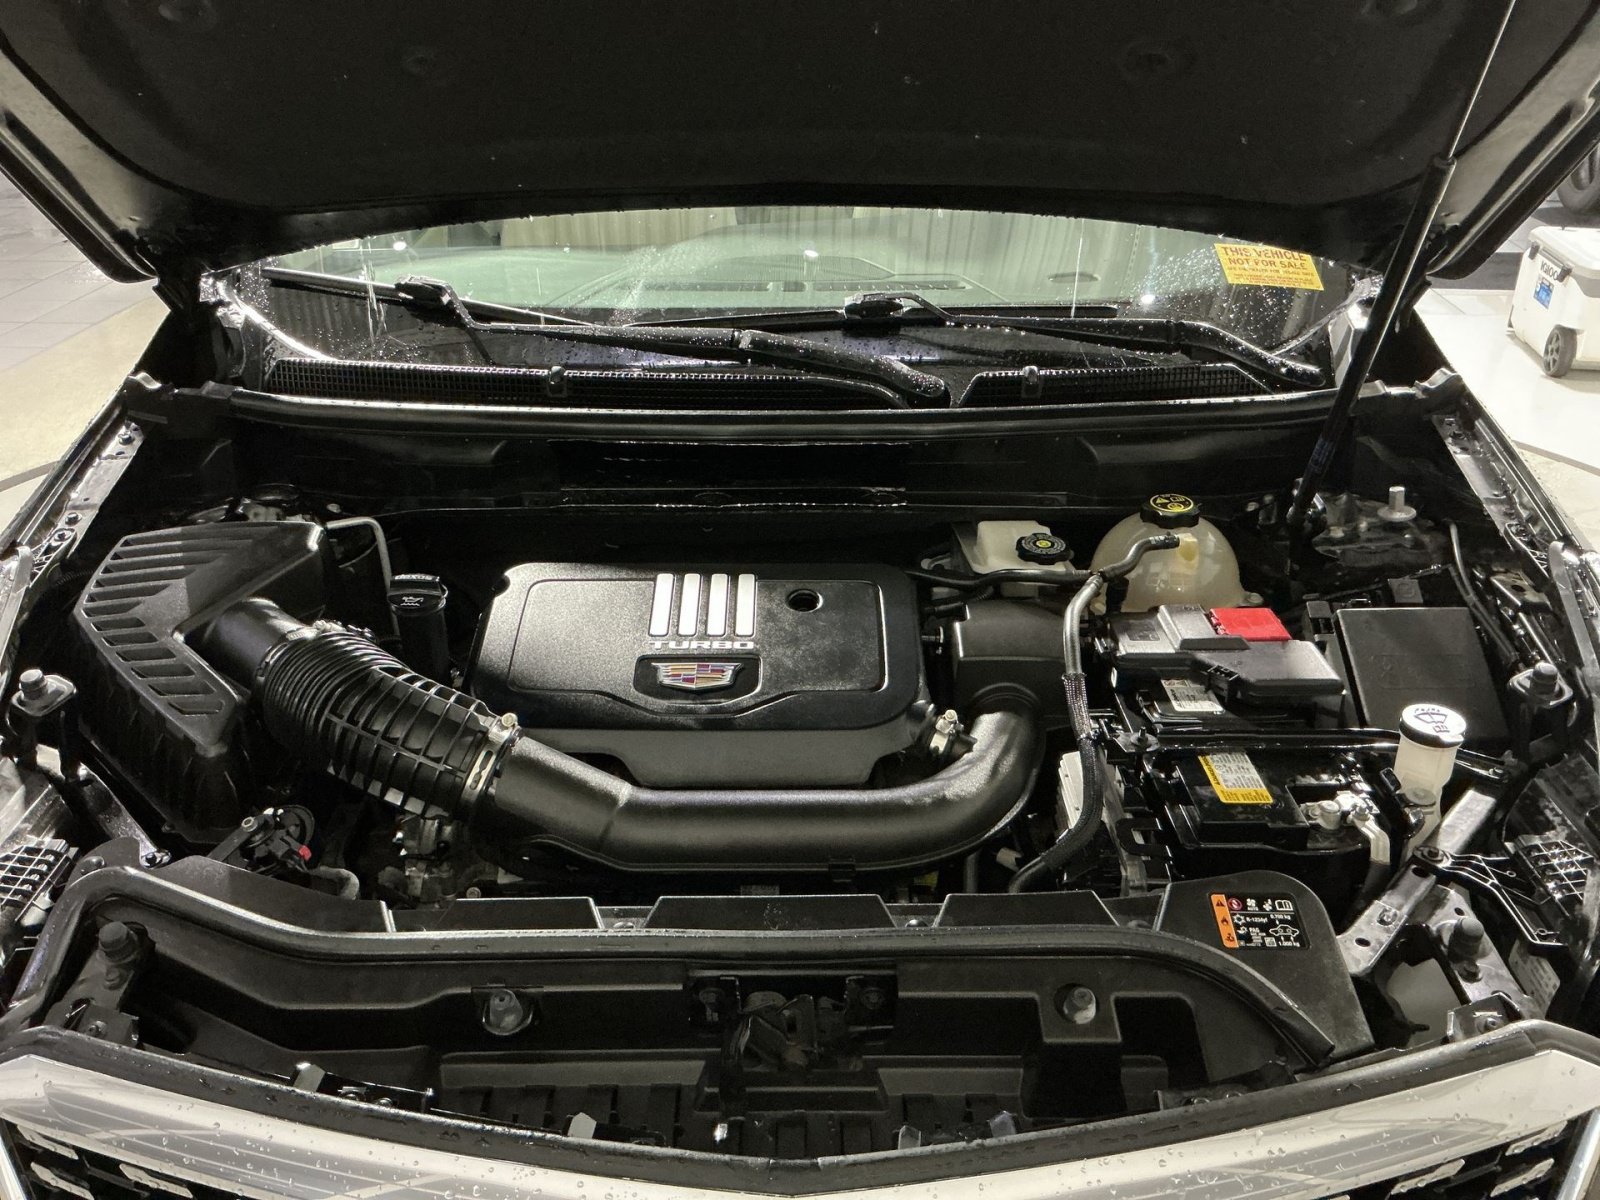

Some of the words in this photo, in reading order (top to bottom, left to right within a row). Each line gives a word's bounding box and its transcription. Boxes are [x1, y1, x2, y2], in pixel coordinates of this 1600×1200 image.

[1221, 246, 1251, 257] THIS
[1253, 247, 1307, 261] VEHICLE
[1229, 258, 1250, 266] NOT
[1254, 258, 1276, 268] FOR
[1280, 260, 1307, 269] SALE
[649, 640, 754, 650] TURBO
